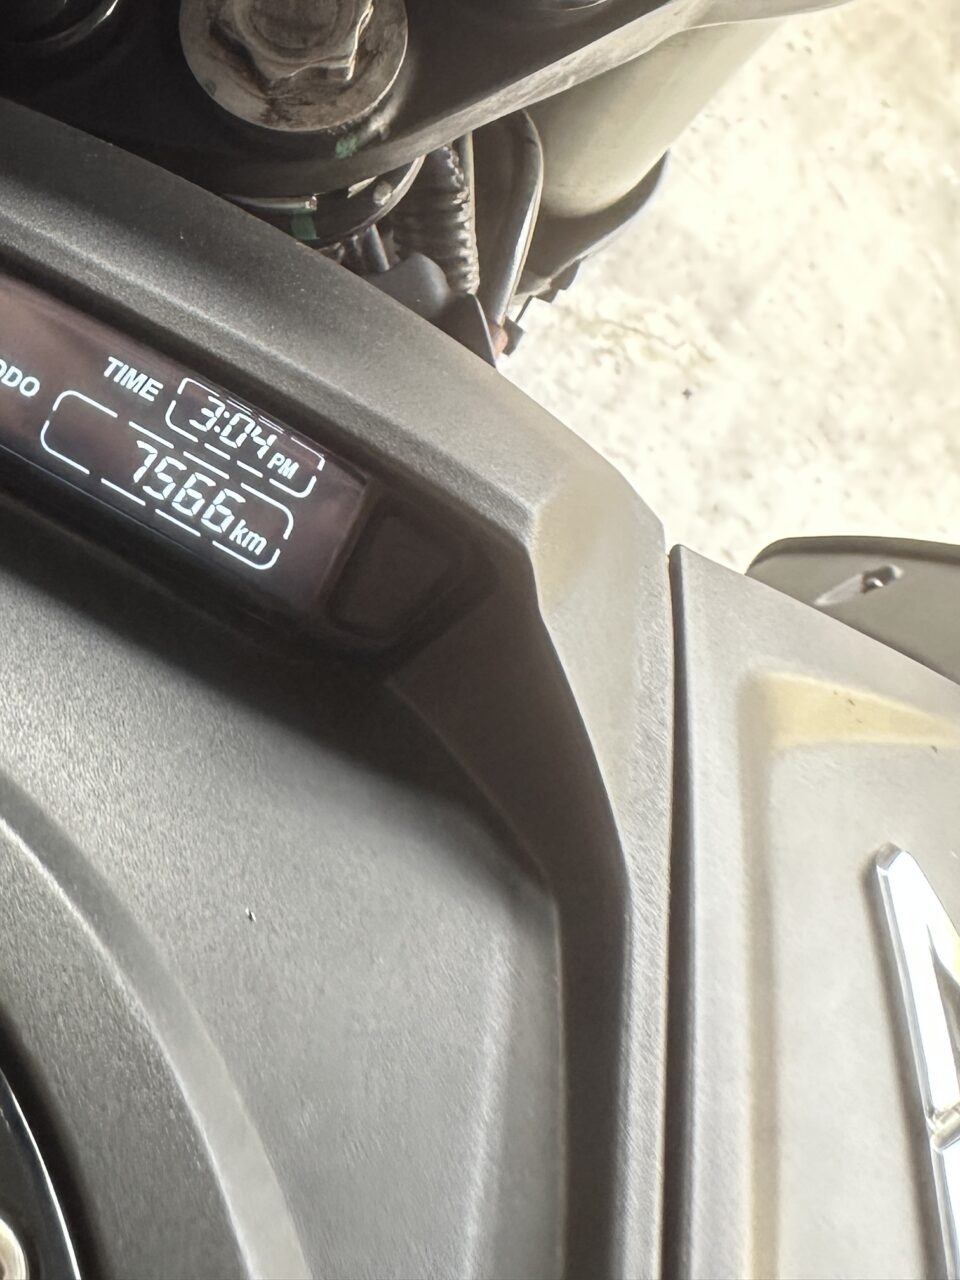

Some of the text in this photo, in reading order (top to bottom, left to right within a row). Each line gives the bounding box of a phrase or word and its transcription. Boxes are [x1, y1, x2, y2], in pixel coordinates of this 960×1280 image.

[103, 356, 300, 480] TIME 3:04 PM
[133, 439, 268, 556] 7566 km
